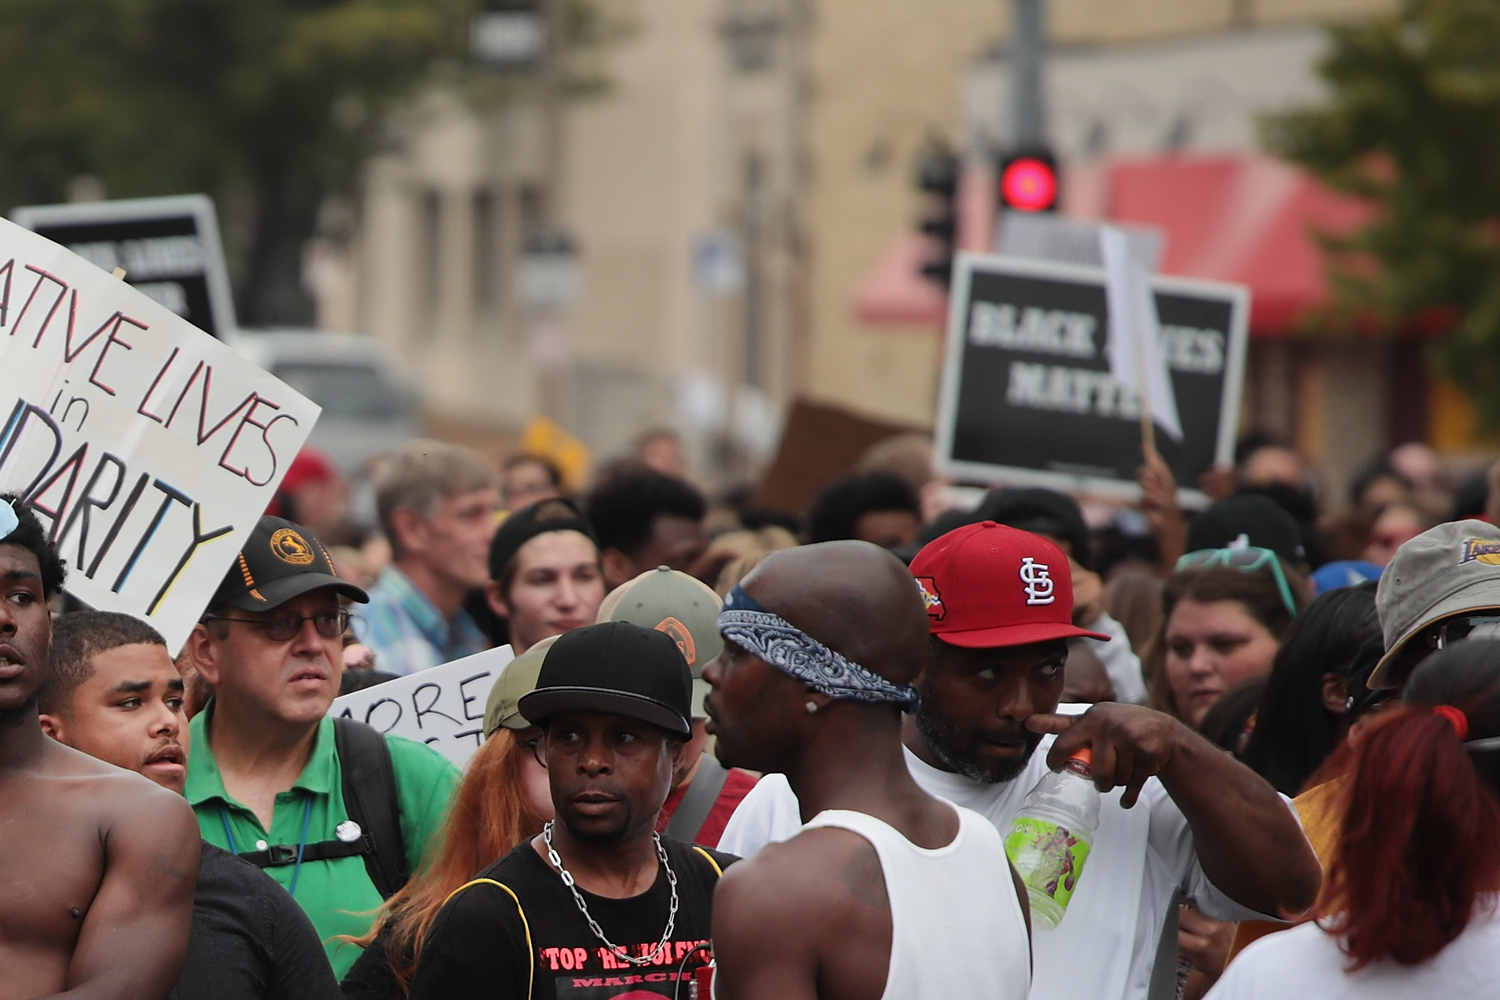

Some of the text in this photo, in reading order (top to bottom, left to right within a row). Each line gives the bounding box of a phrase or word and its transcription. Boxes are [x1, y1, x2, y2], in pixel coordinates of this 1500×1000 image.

[968, 300, 1097, 358] BLACK
[49, 380, 90, 432] in
[137, 347, 299, 487] LIVES
[341, 671, 501, 733] ORE
